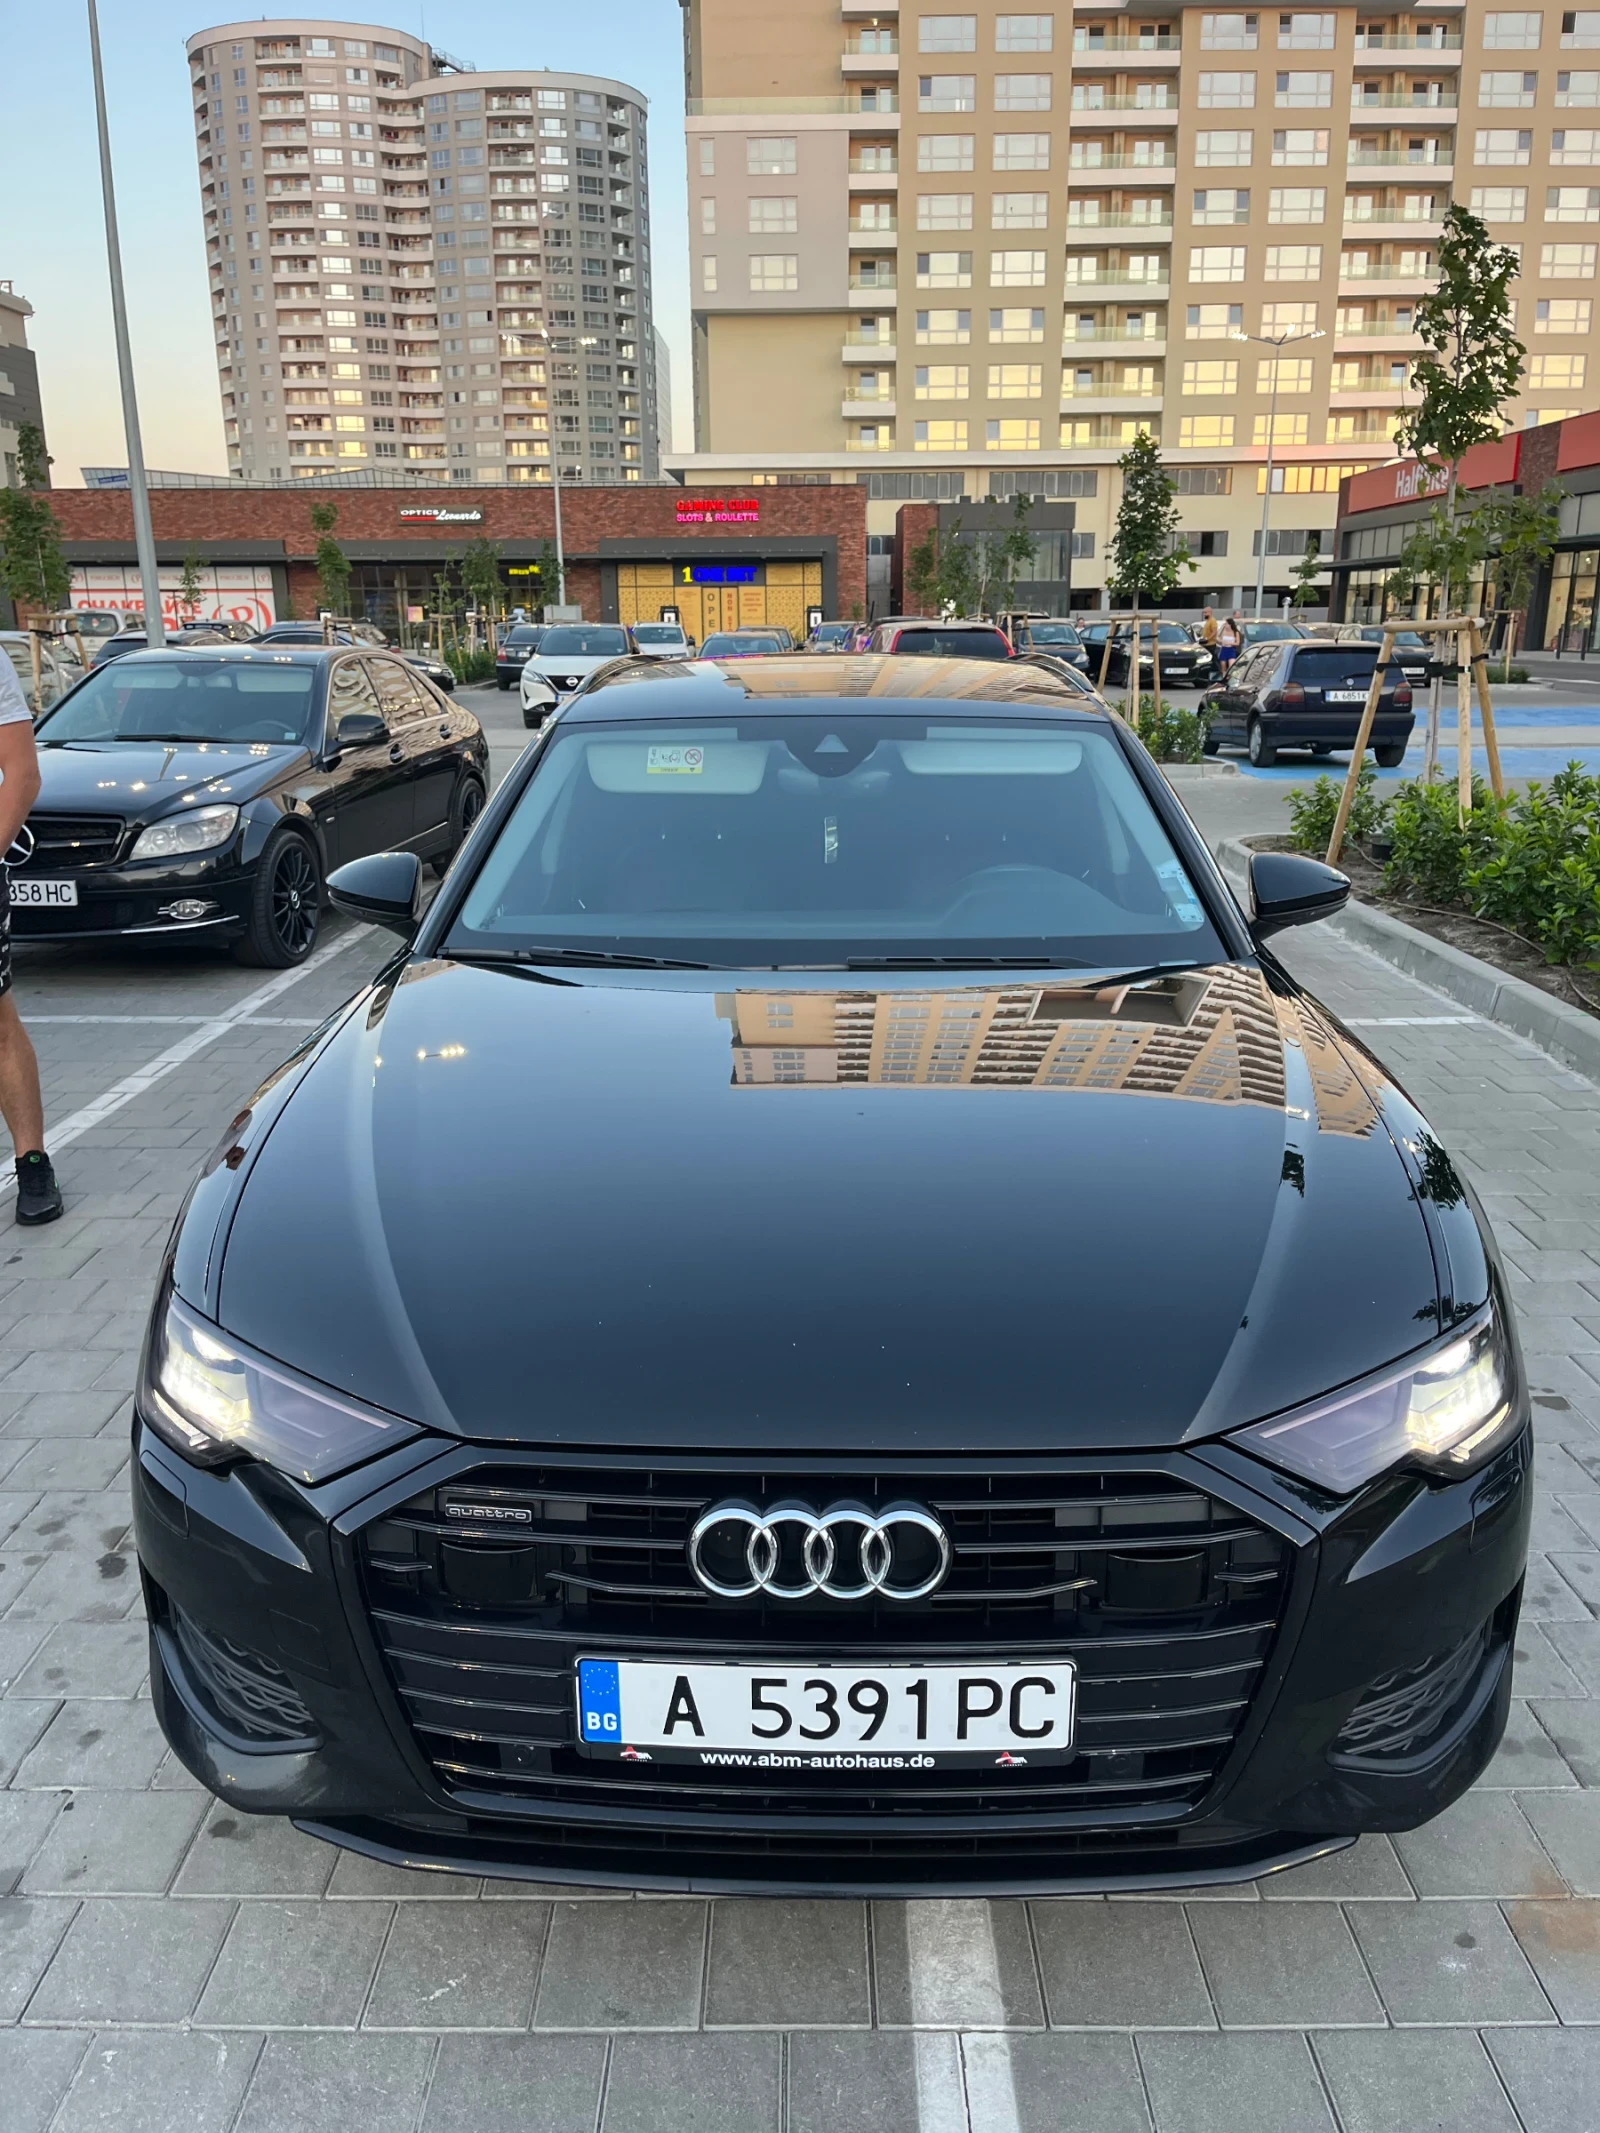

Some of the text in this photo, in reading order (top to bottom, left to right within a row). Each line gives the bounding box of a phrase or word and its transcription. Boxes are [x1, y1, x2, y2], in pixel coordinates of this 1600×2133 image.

[676, 500, 759, 511] GAMING CLUB
[435, 509, 482, 520] Leonardo
[676, 512, 759, 522] SLOTS & ROULETTE
[77, 595, 202, 614] ОЧАКВЙТЕ
[707, 593, 716, 635] OPE
[46, 884, 72, 903] HC
[448, 1507, 527, 1520] quattro
[662, 1675, 705, 1737] A
[586, 1711, 618, 1731] BG
[700, 1752, 936, 1768] www.abm-autohaus.de
